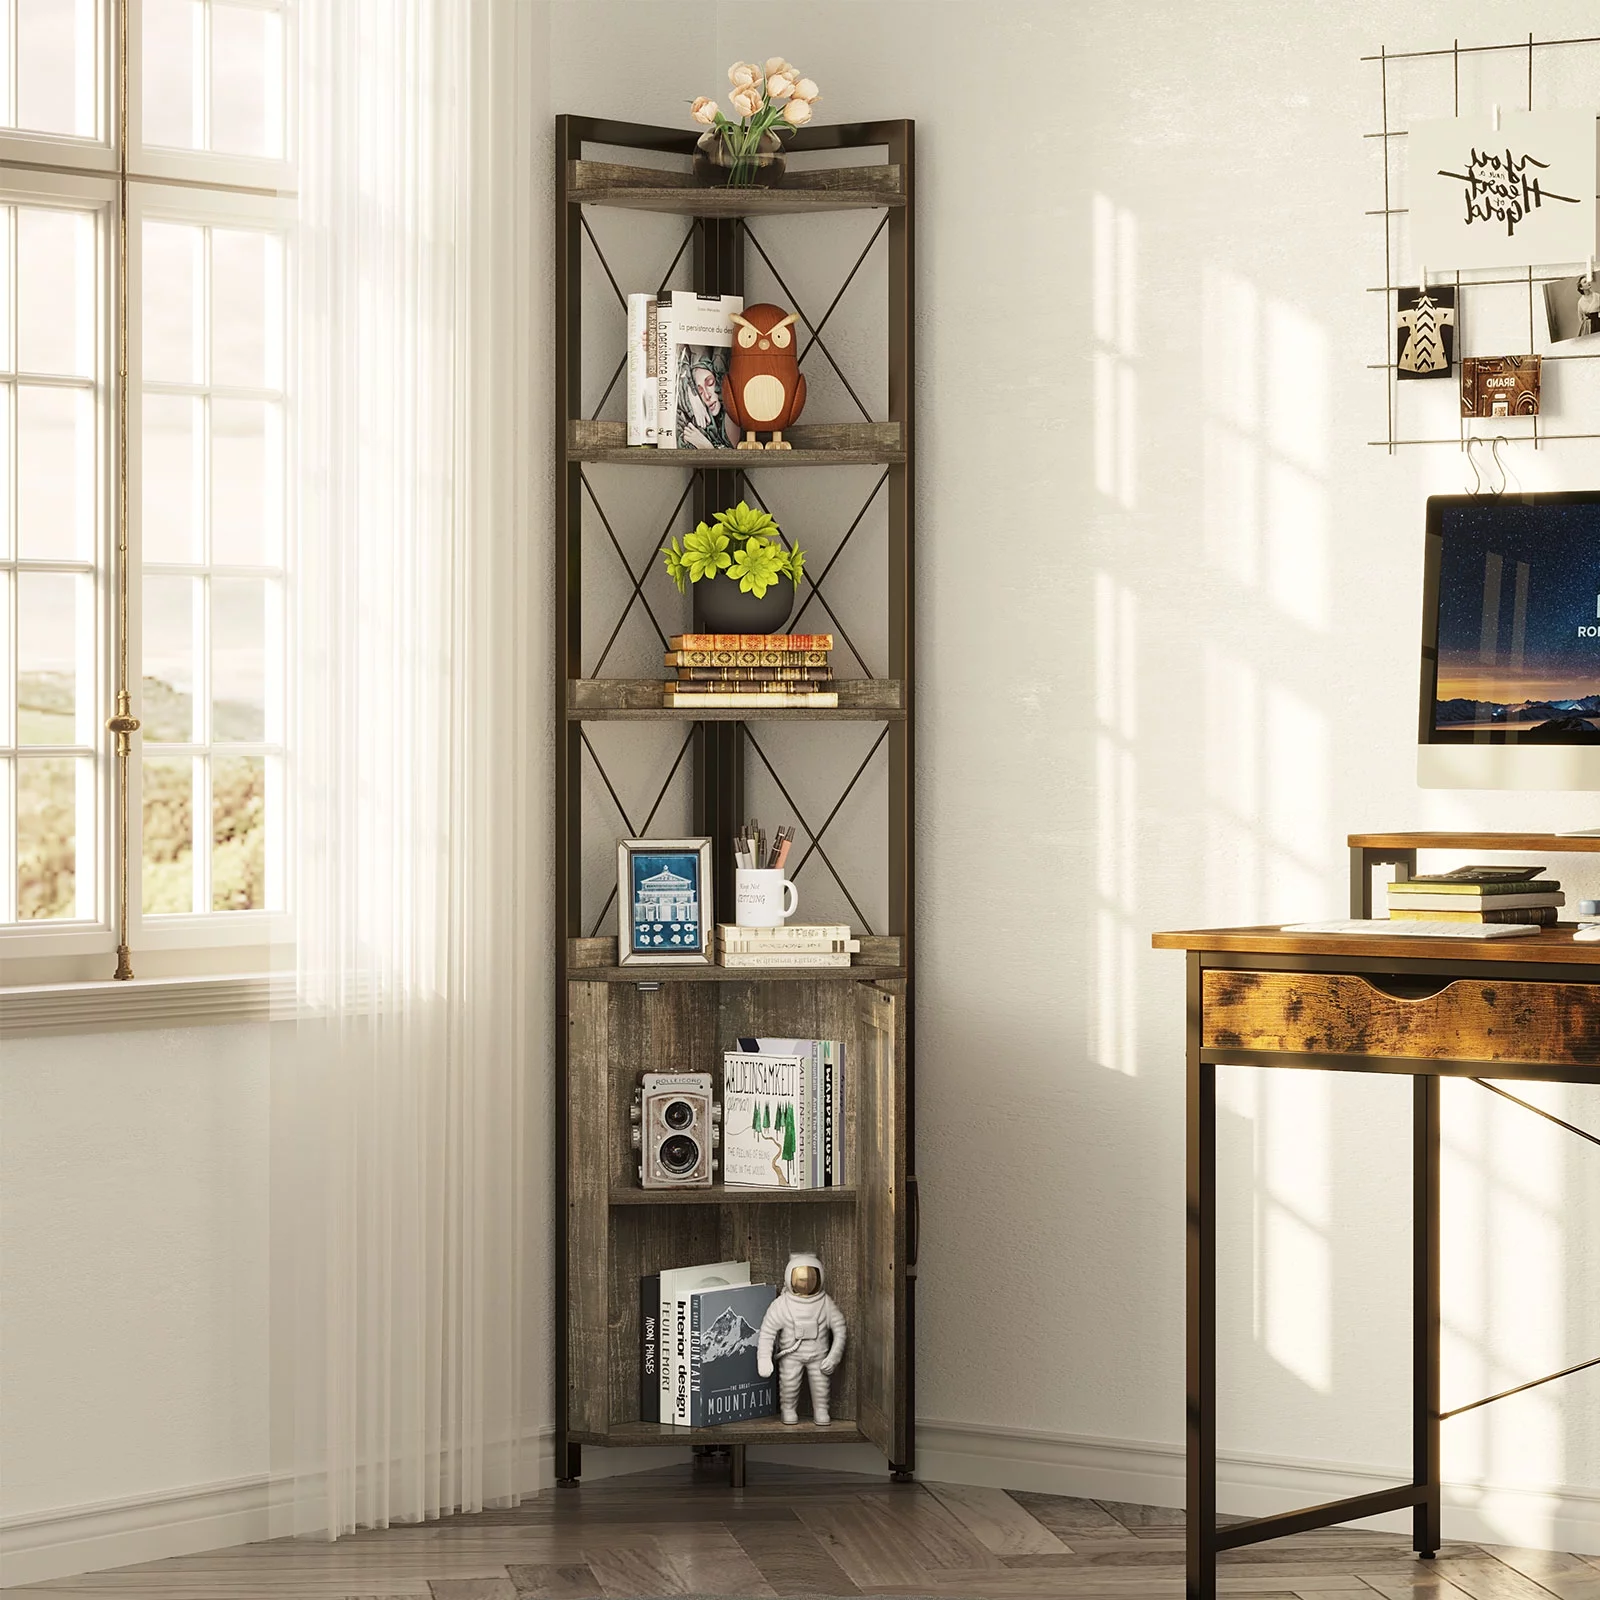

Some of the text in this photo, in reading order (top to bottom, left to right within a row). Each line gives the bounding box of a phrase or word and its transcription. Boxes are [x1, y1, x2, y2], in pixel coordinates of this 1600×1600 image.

[679, 322, 685, 331] La
[686, 324, 715, 335] persistance
[716, 325, 722, 334] du
[658, 332, 671, 374] persistance
[659, 377, 671, 386] du
[659, 389, 672, 412] destin
[724, 1060, 796, 1097] WALDEINSAMKEIT
[645, 1316, 655, 1375] MOON PHASES
[662, 1301, 672, 1393] FEUILLEMORT
[676, 1301, 688, 1418] Interior design
[690, 1330, 701, 1392] MOUNTAIN
[708, 1387, 772, 1416] MOUNTAIN
[738, 1382, 751, 1391] GREAT
